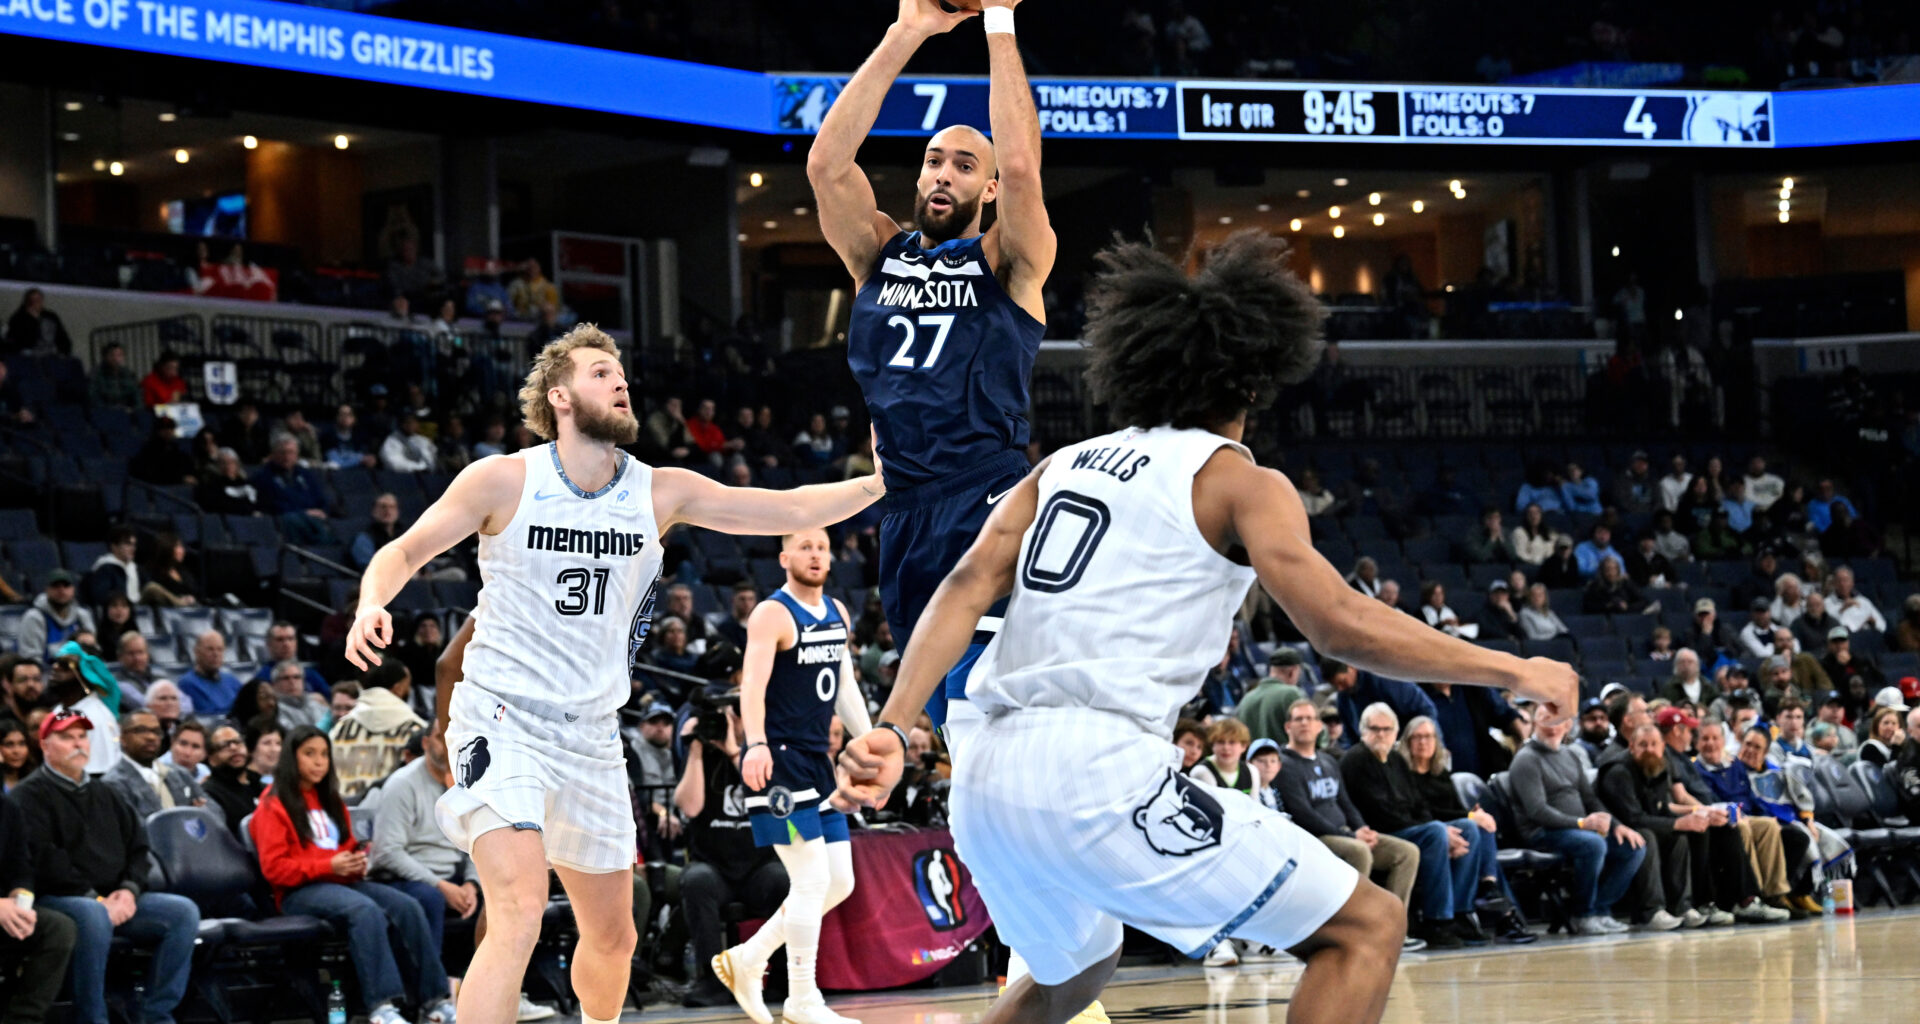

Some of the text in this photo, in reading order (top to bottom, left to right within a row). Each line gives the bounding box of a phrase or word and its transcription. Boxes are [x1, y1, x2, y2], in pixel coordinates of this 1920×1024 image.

[0, 0, 494, 81] ACE OF THE MEMPHIS GRIZZLIES
[913, 83, 947, 130] 7
[1202, 93, 1275, 130] 1ST QTR
[1303, 89, 1375, 134] 9:45
[1624, 95, 1657, 139] 4
[887, 313, 957, 369] 27
[1071, 447, 1151, 482] WELLS
[527, 525, 644, 559] memphis
[1022, 490, 1111, 593] 0
[555, 567, 610, 616] 31
[816, 667, 836, 702] 0
